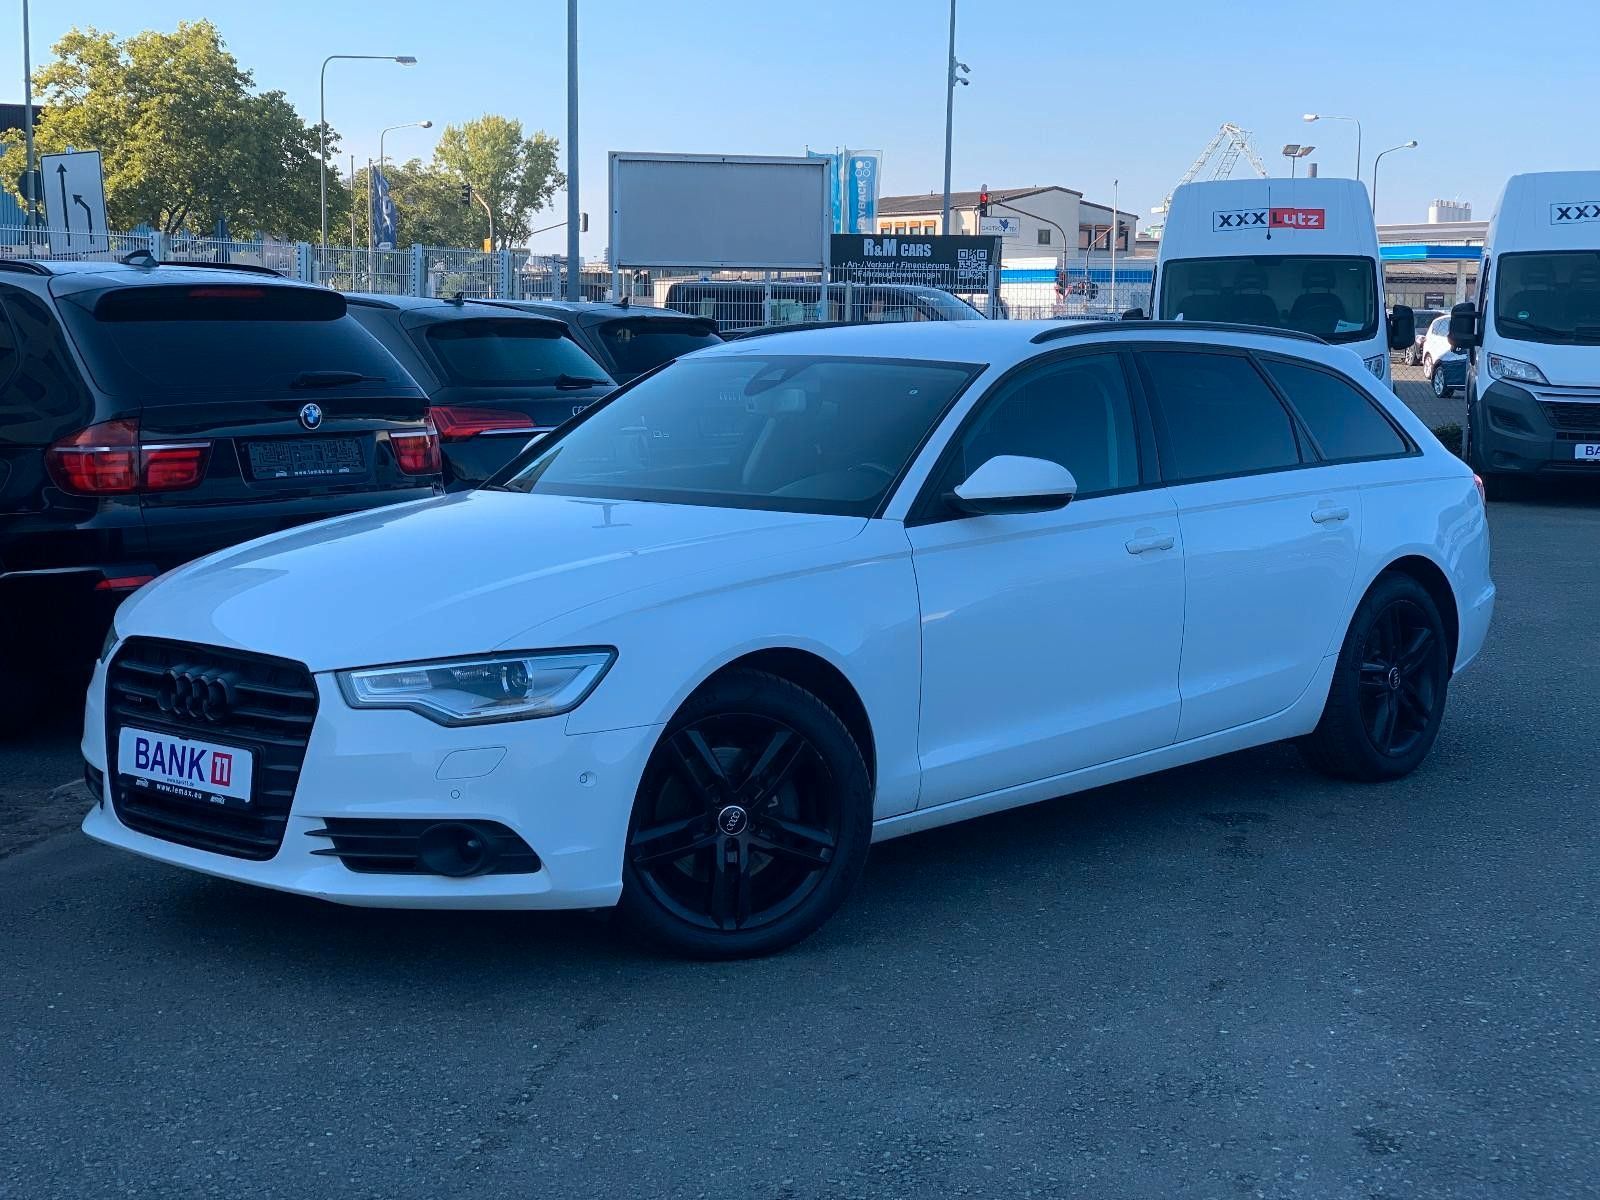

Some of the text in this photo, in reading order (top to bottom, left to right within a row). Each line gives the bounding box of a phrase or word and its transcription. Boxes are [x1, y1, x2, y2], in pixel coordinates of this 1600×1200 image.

[857, 180, 867, 230] PAYBACK
[863, 238, 932, 257] R&M CARS
[900, 261, 950, 270] Finanzierung
[135, 737, 230, 783] BANK 11
[156, 783, 202, 800] www.lemax.eu
